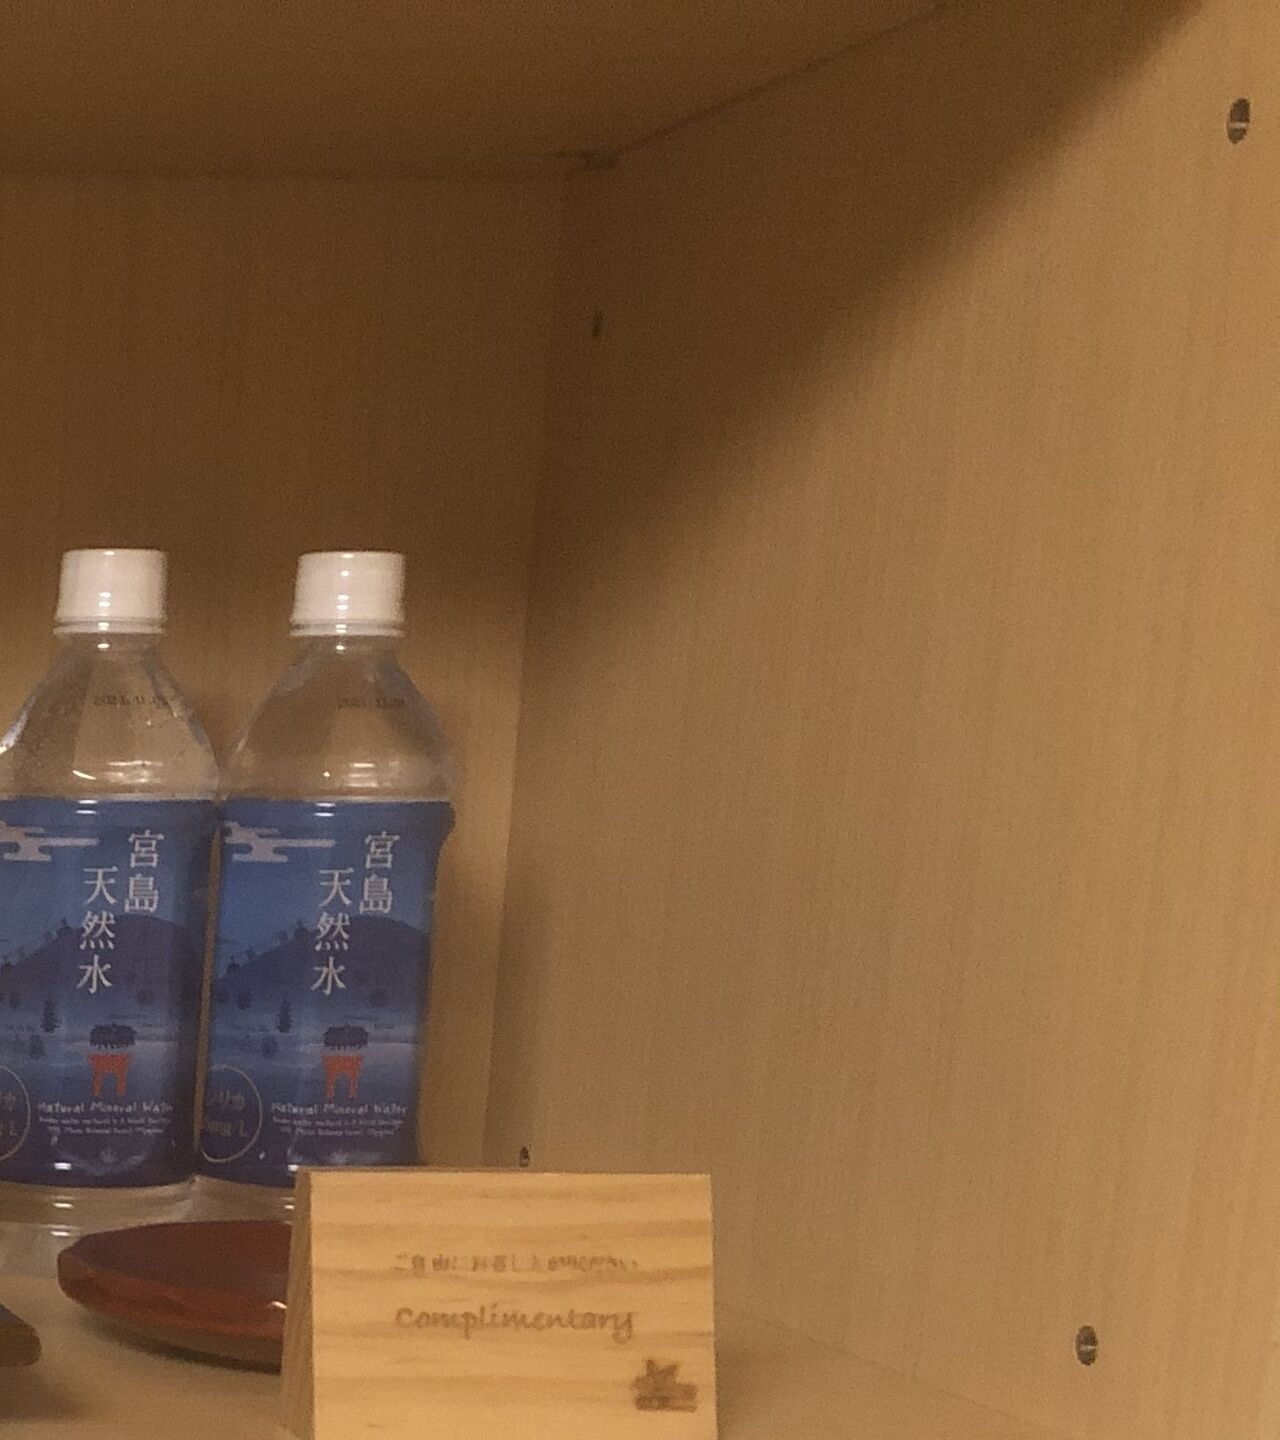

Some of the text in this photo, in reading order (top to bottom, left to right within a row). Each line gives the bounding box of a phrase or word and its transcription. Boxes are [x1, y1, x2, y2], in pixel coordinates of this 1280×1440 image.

[124, 829, 165, 915] 宮島
[358, 830, 401, 916] 宮島
[75, 865, 120, 995] 天然水
[310, 866, 355, 996] 天然水
